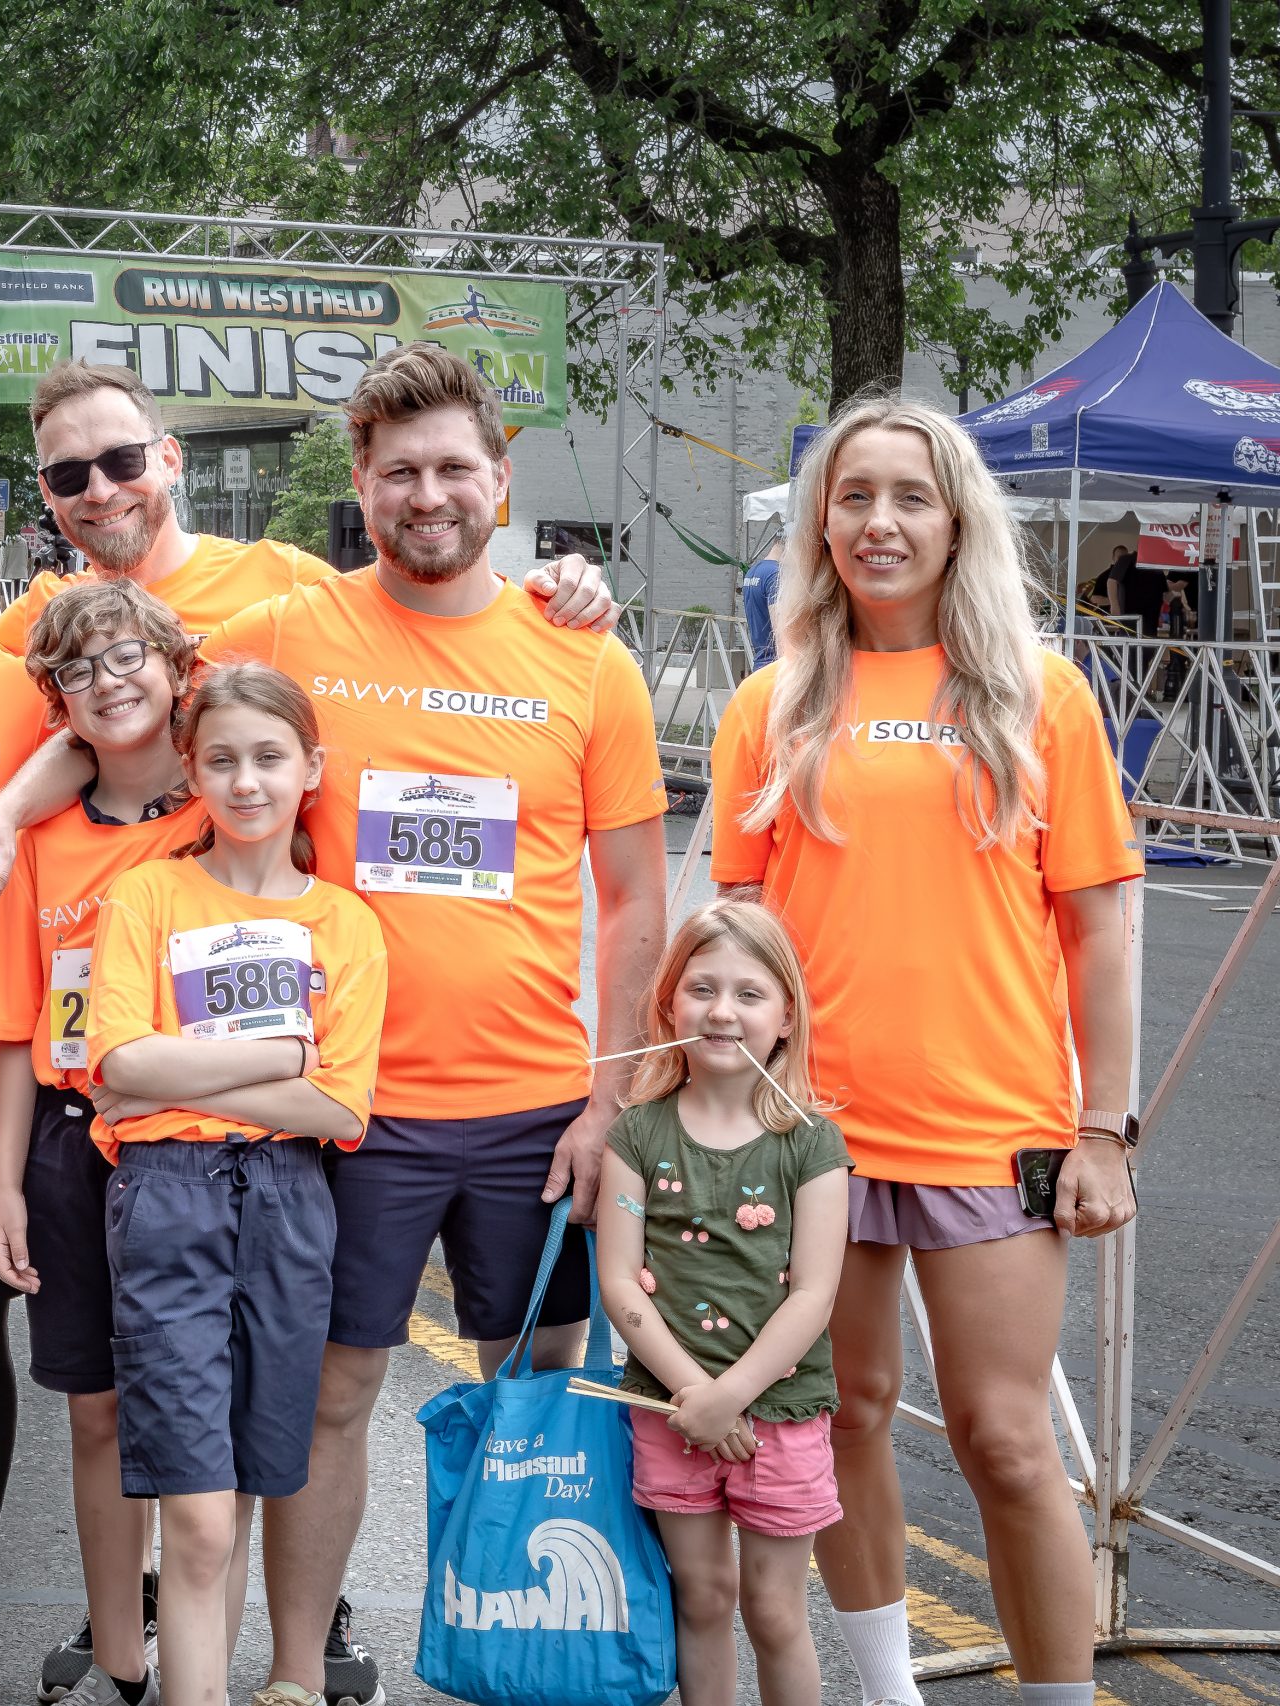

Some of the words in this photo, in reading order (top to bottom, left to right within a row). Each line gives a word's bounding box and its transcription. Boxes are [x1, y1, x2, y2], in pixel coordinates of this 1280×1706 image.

[54, 283, 85, 291] BANK
[142, 276, 212, 310] RUN
[219, 280, 384, 318] WESTFIELD
[70, 321, 447, 405] FINIS
[467, 349, 545, 391] RUN
[496, 388, 544, 404] stfield
[232, 454, 241, 462] ONE
[227, 477, 247, 485] PARKING
[1149, 521, 1200, 538] MEDIC
[312, 676, 418, 706] SAVVY
[428, 690, 547, 720] SOURCE
[874, 721, 967, 744] SOUR
[388, 814, 482, 868] 585
[39, 896, 104, 928] SAV
[204, 959, 300, 1016] 586
[62, 991, 86, 1038] 2
[533, 1433, 544, 1448] a
[483, 1451, 587, 1481] Pleasant
[544, 1476, 594, 1504] Day!
